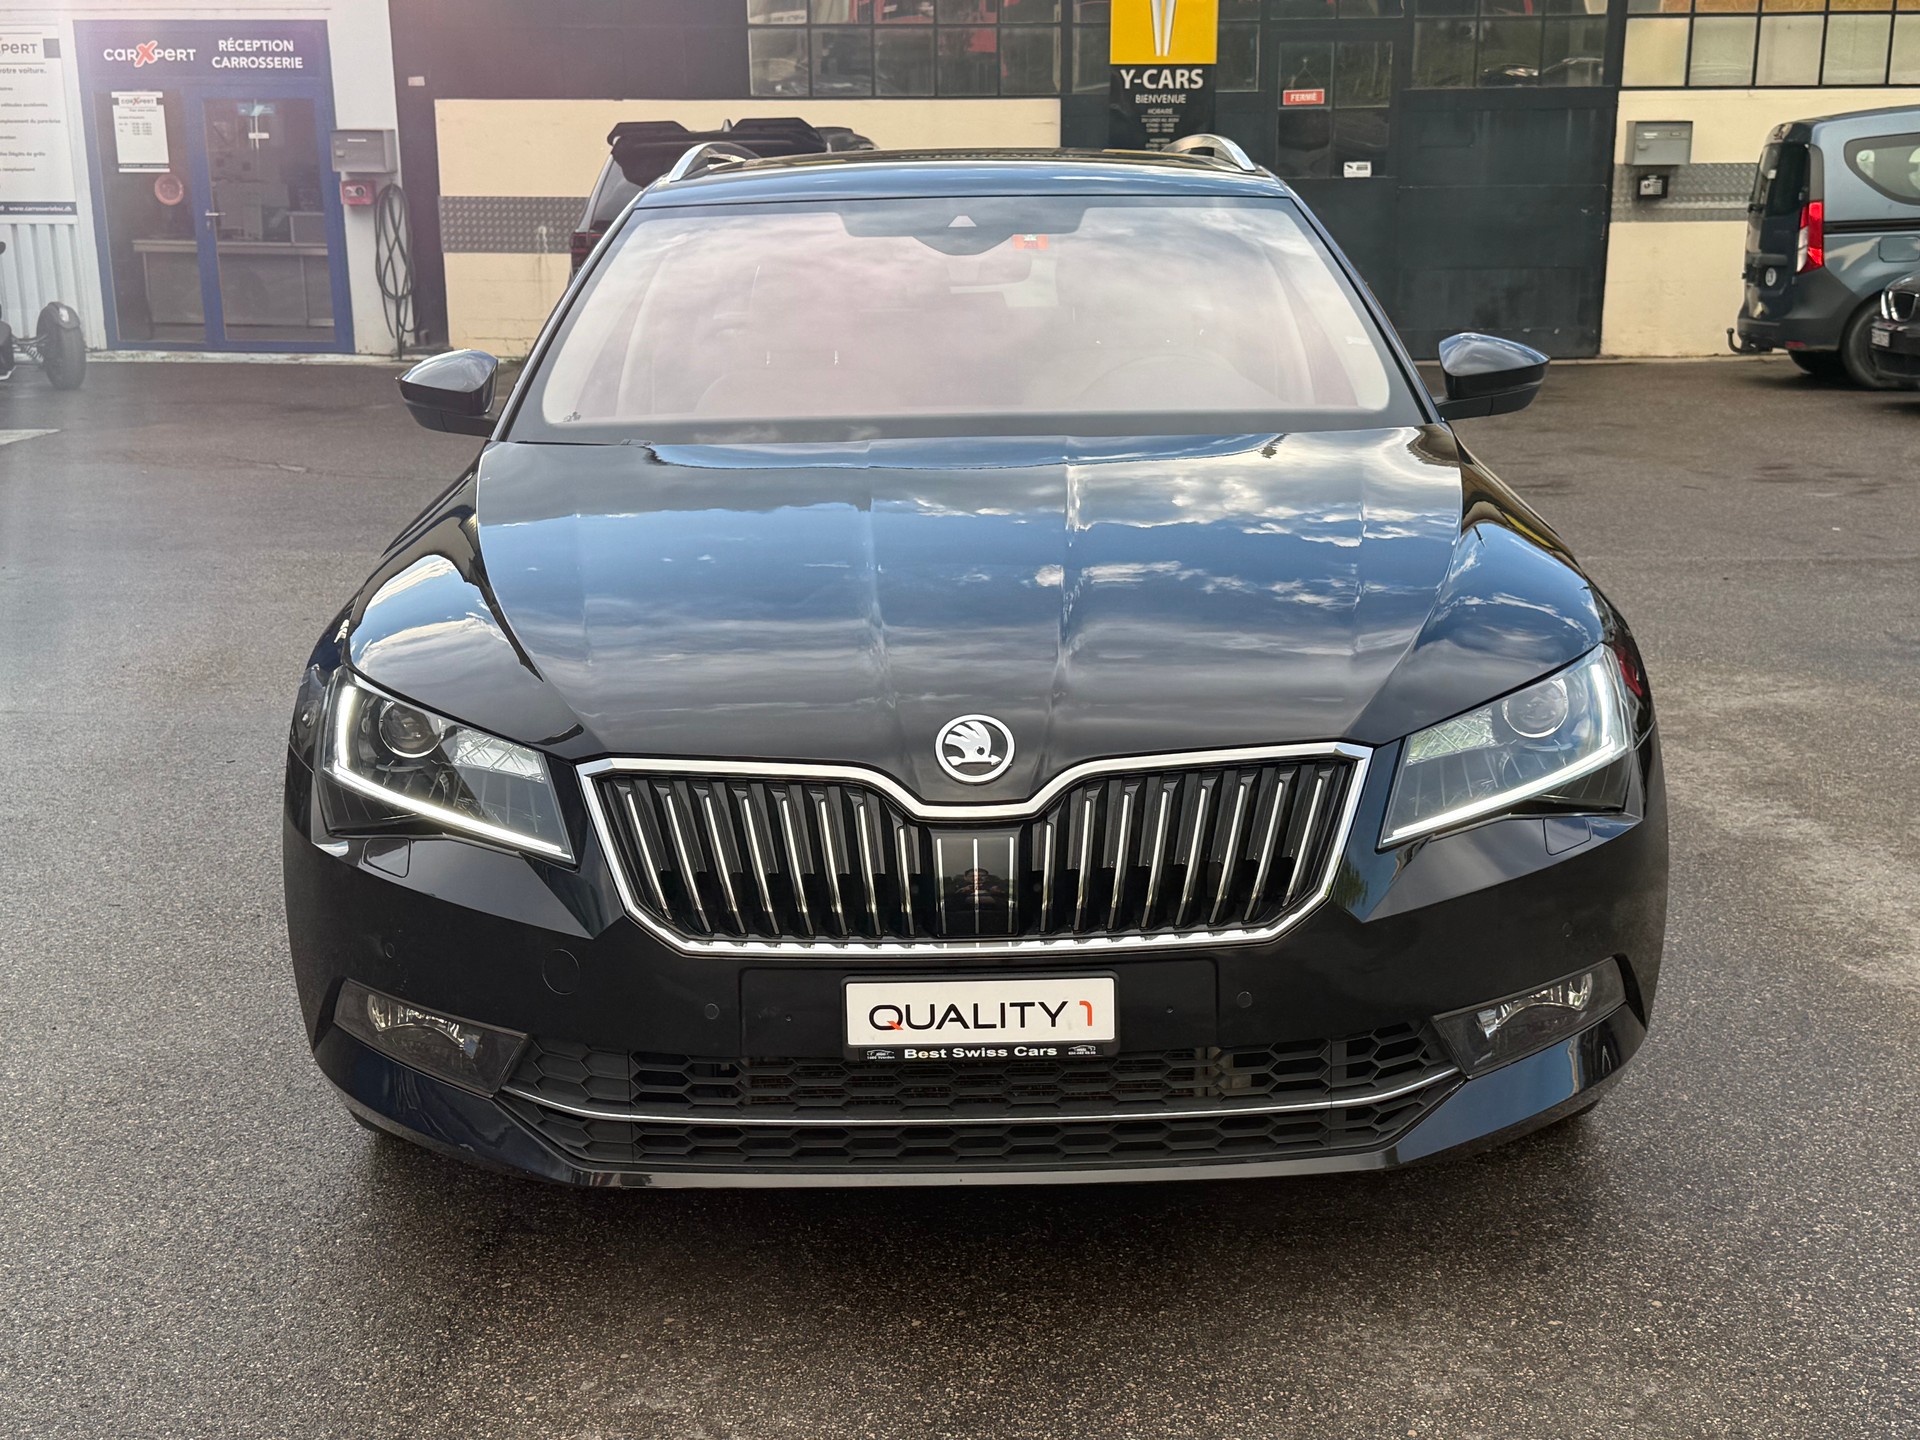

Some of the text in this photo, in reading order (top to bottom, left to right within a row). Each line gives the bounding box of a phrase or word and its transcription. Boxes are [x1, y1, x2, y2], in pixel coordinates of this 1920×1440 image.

[218, 37, 294, 52] RÉCEPTION
[211, 56, 304, 69] CARROSSERIE
[1119, 68, 1204, 90] Y-CARS
[1135, 94, 1187, 104] BIENVENUE
[1290, 92, 1317, 102] FERMÉ
[868, 1000, 1093, 1031] QUALITY 1
[904, 1047, 947, 1059] Best
[952, 1046, 1008, 1059] Swiss
[1014, 1045, 1058, 1057] Cars
